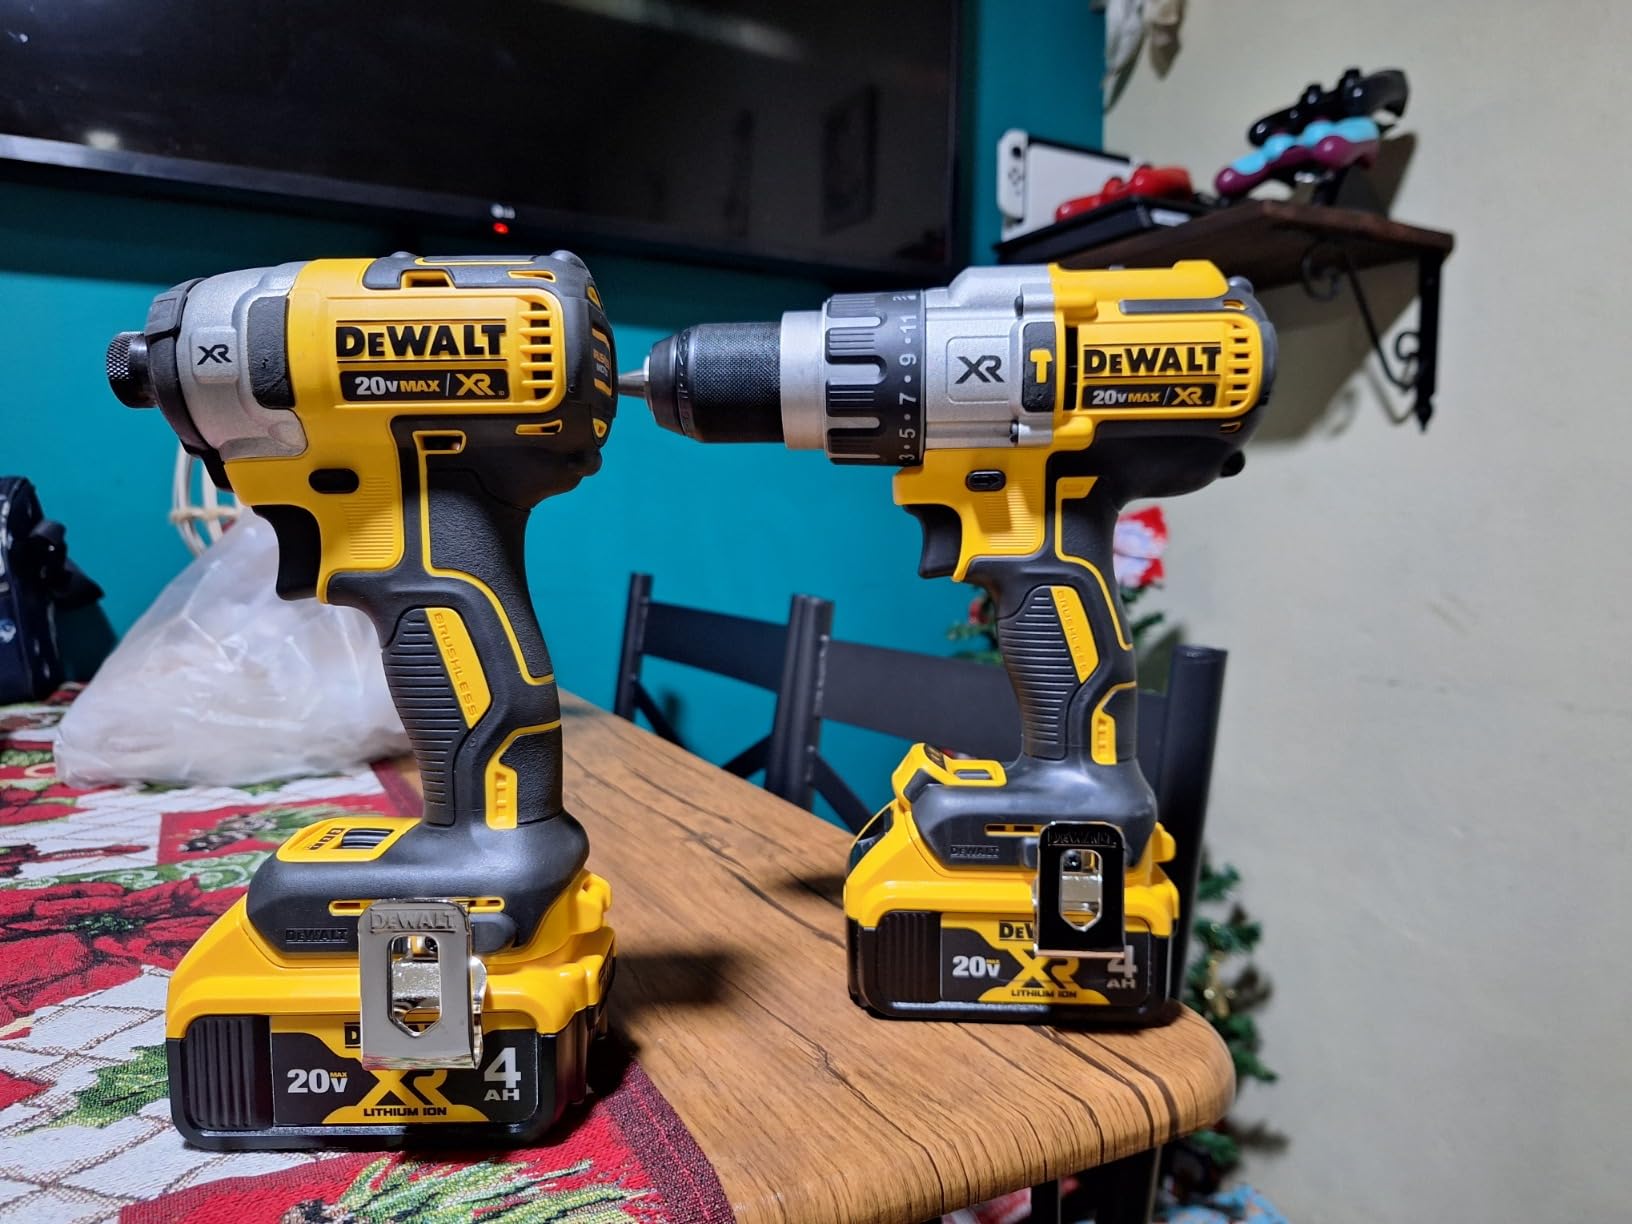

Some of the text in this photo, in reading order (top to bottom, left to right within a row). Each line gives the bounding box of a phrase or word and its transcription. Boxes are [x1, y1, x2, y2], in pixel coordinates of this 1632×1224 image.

[900, 315, 917, 334] 11
[335, 324, 506, 358] DEWALT
[197, 343, 232, 366] XR
[899, 353, 917, 367] 9
[1083, 346, 1222, 375] DEWALT
[954, 355, 1005, 385] XR
[455, 373, 496, 396] XR
[899, 392, 917, 405] 7
[1171, 386, 1204, 406] XR
[899, 428, 916, 439] 5
[434, 612, 478, 717] BRUSHLESS
[370, 910, 457, 930] DEWALT
[284, 928, 349, 943] DEWALT
[1006, 949, 1082, 989] XR
[1011, 989, 1077, 998] LITHIUM ION
[483, 1046, 522, 1089] 4
[483, 1088, 520, 1101] AH
[363, 1106, 447, 1117] LITHIUM ION
